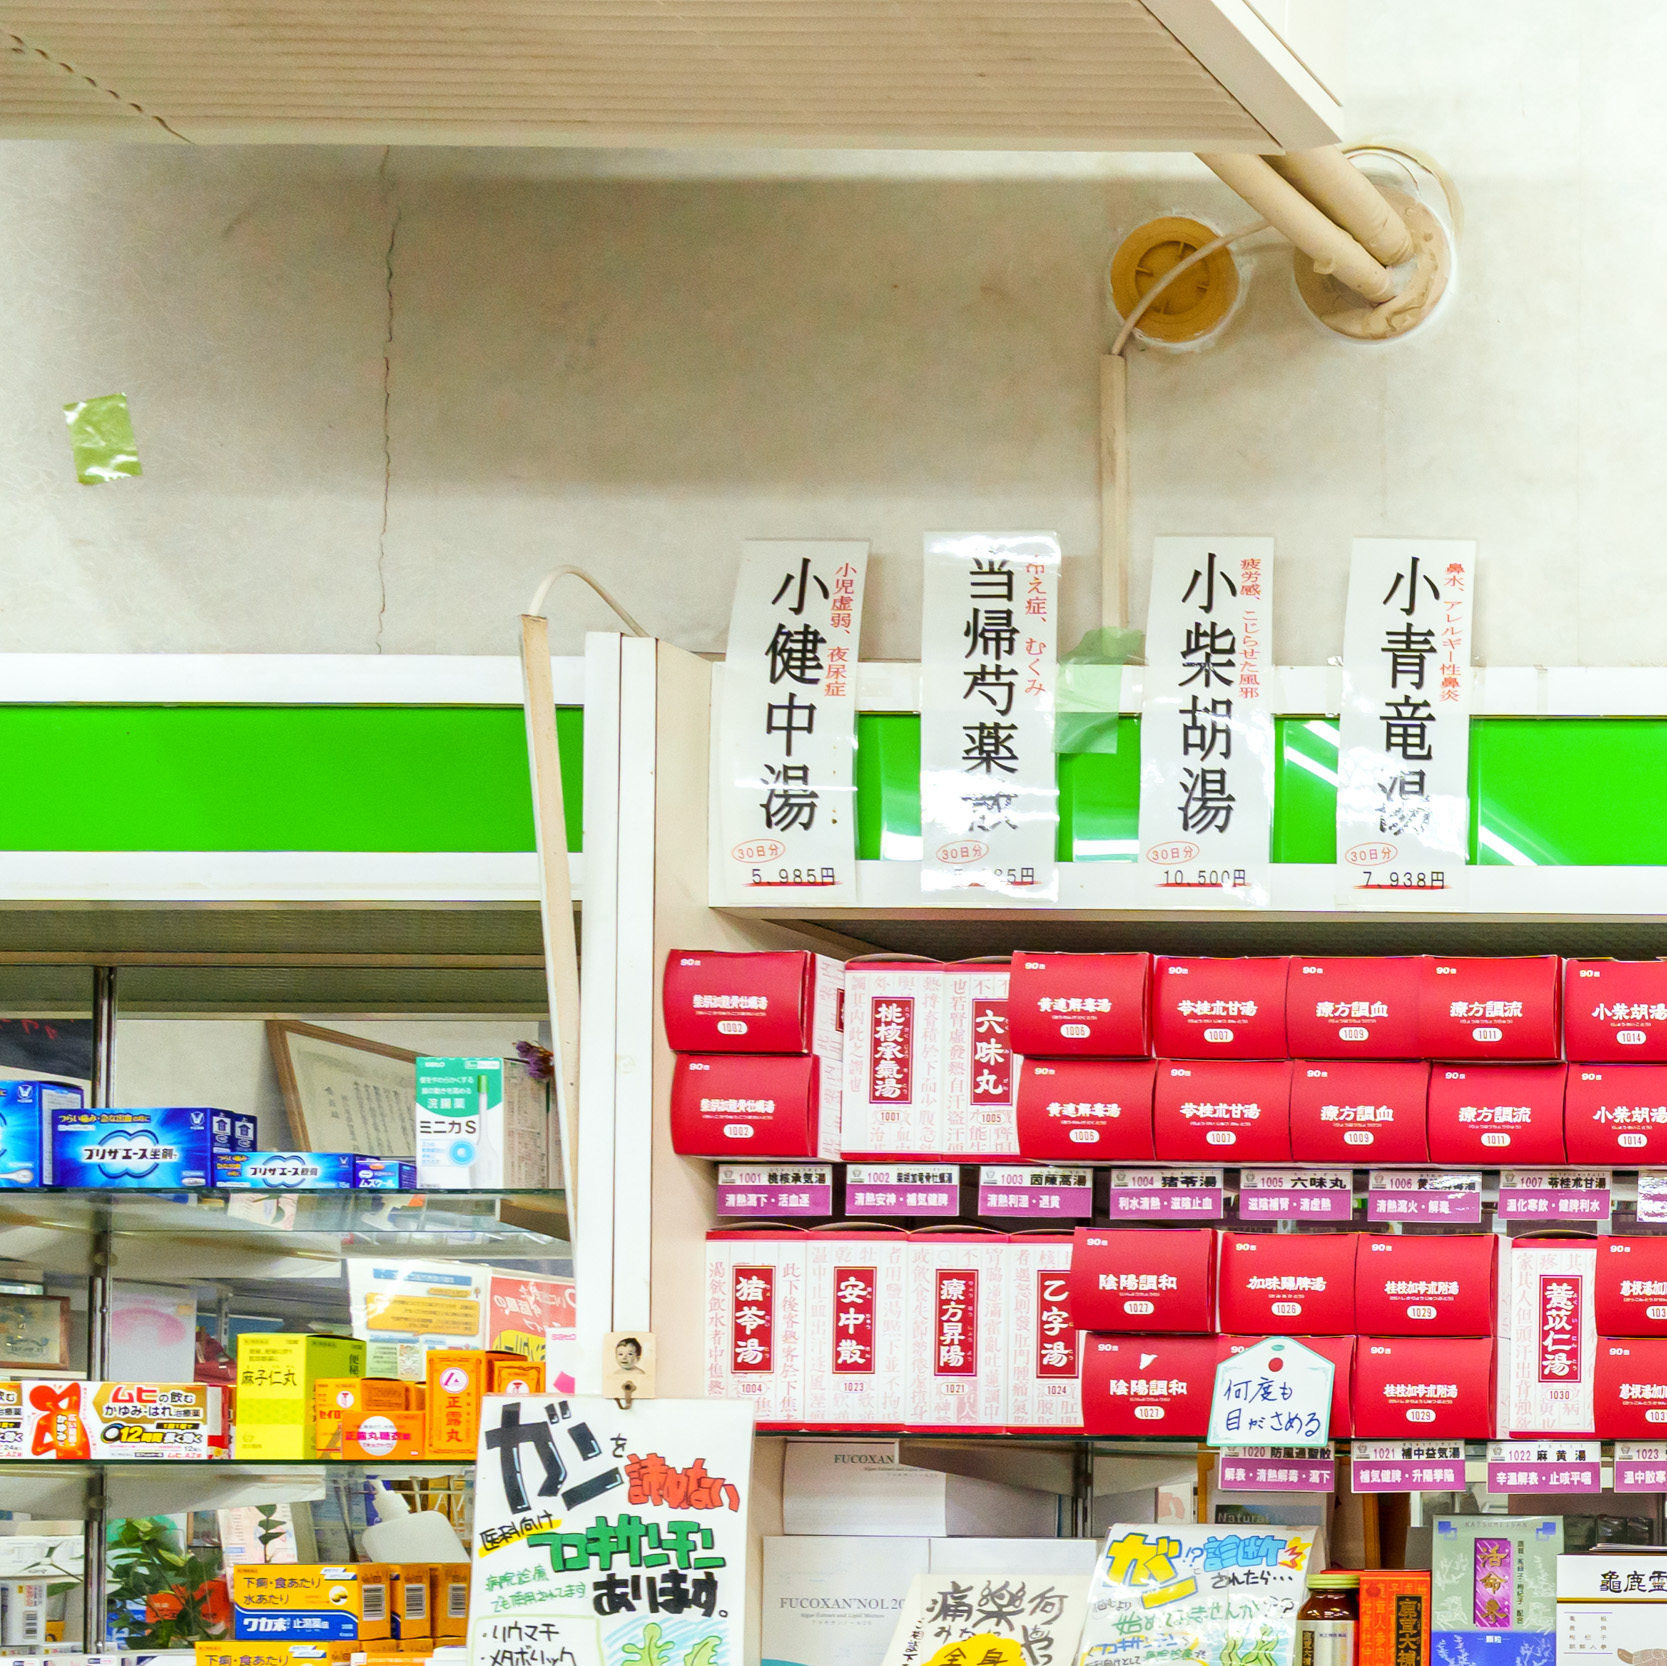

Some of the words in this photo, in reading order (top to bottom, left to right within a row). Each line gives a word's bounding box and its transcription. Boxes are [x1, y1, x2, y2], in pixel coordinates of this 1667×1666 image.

[759, 556, 830, 834] 小健中湯
[1179, 551, 1239, 835] 小柴胡湯
[1377, 555, 1443, 837] 小青竜湯
[735, 841, 782, 861] 30日分
[975, 1009, 1004, 1096] 六味丸
[1131, 1175, 1155, 1187] 1004
[1161, 1175, 1218, 1188] 猪苓湯
[838, 1276, 868, 1366] 安中散
[241, 1368, 298, 1387] 麻子仁丸
[1223, 1377, 1294, 1403] 何度も
[446, 1395, 463, 1443] 正露丸
[1224, 1408, 1321, 1438] 目がさめる
[1636, 1448, 1660, 1461] 1023
[242, 1592, 290, 1607] 水あたり
[593, 1569, 729, 1619] あります。
